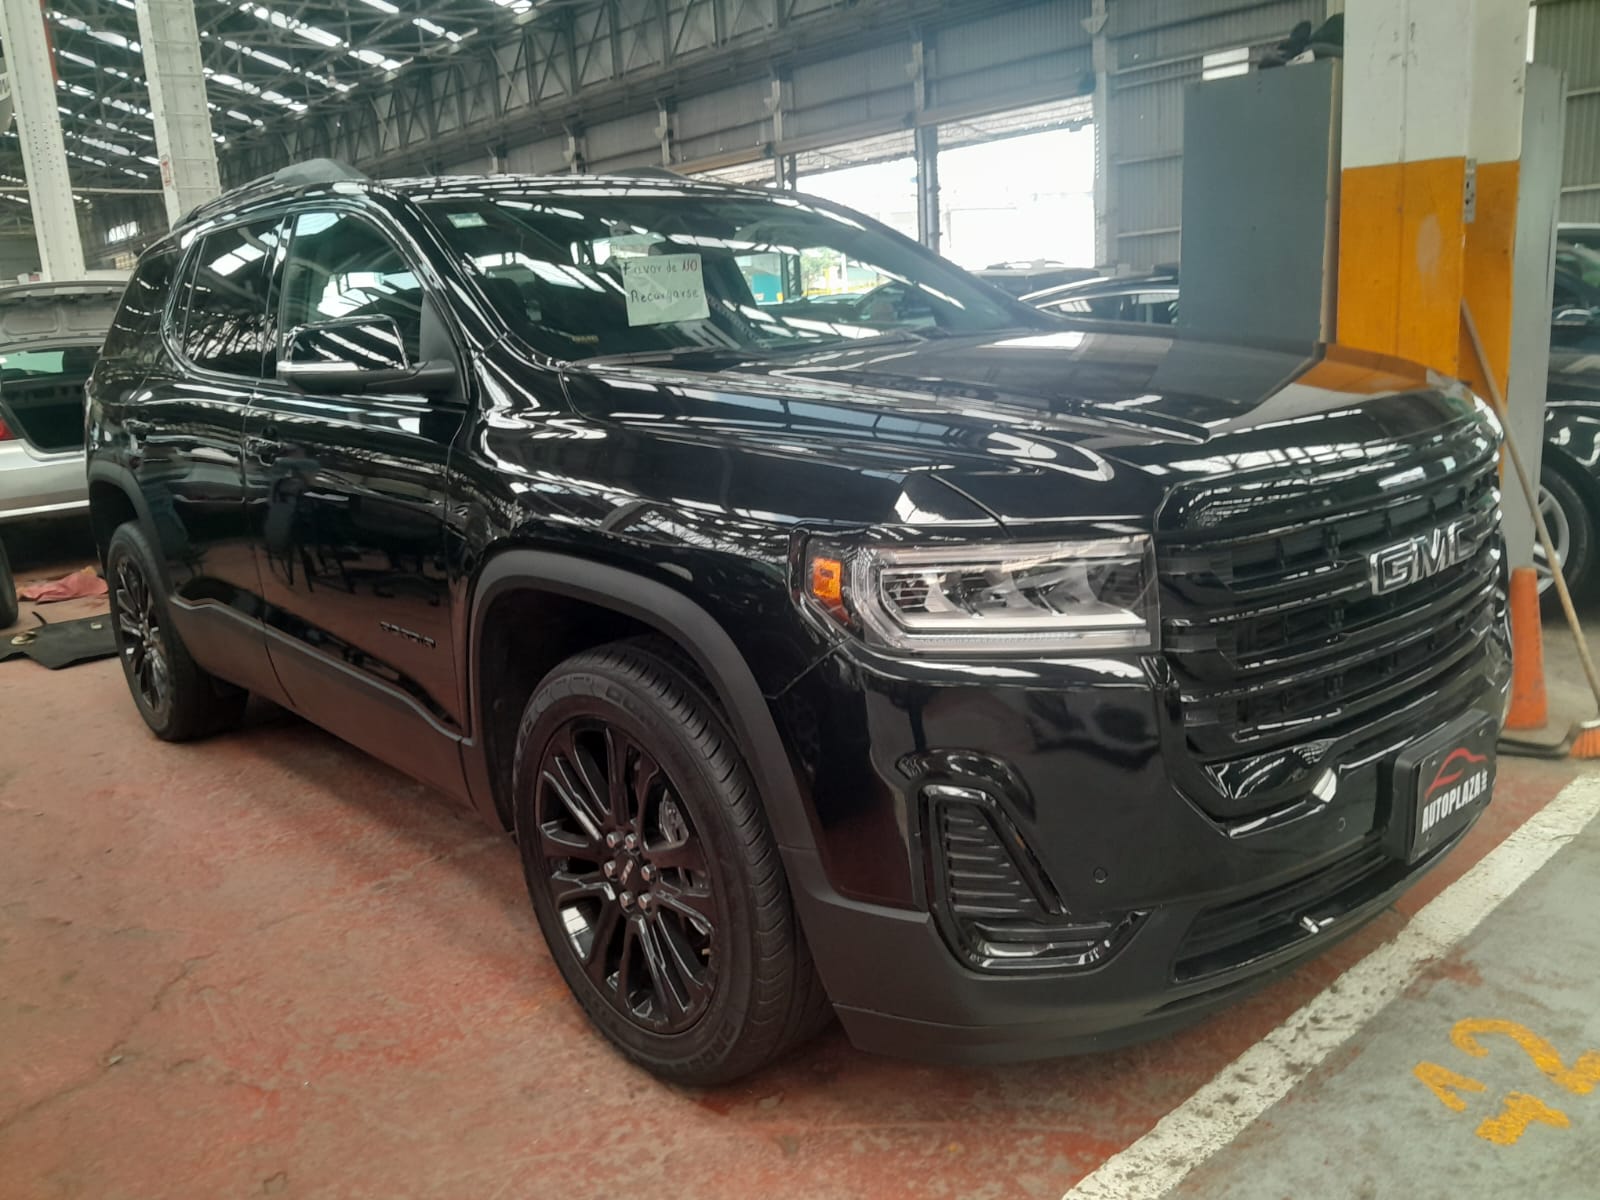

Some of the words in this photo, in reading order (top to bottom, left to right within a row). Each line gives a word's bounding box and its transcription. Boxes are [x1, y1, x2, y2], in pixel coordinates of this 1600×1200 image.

[623, 261, 663, 275] Favor
[666, 261, 678, 273] de
[1369, 516, 1479, 596] GMC
[1421, 771, 1481, 833] AUTOPLAZA
